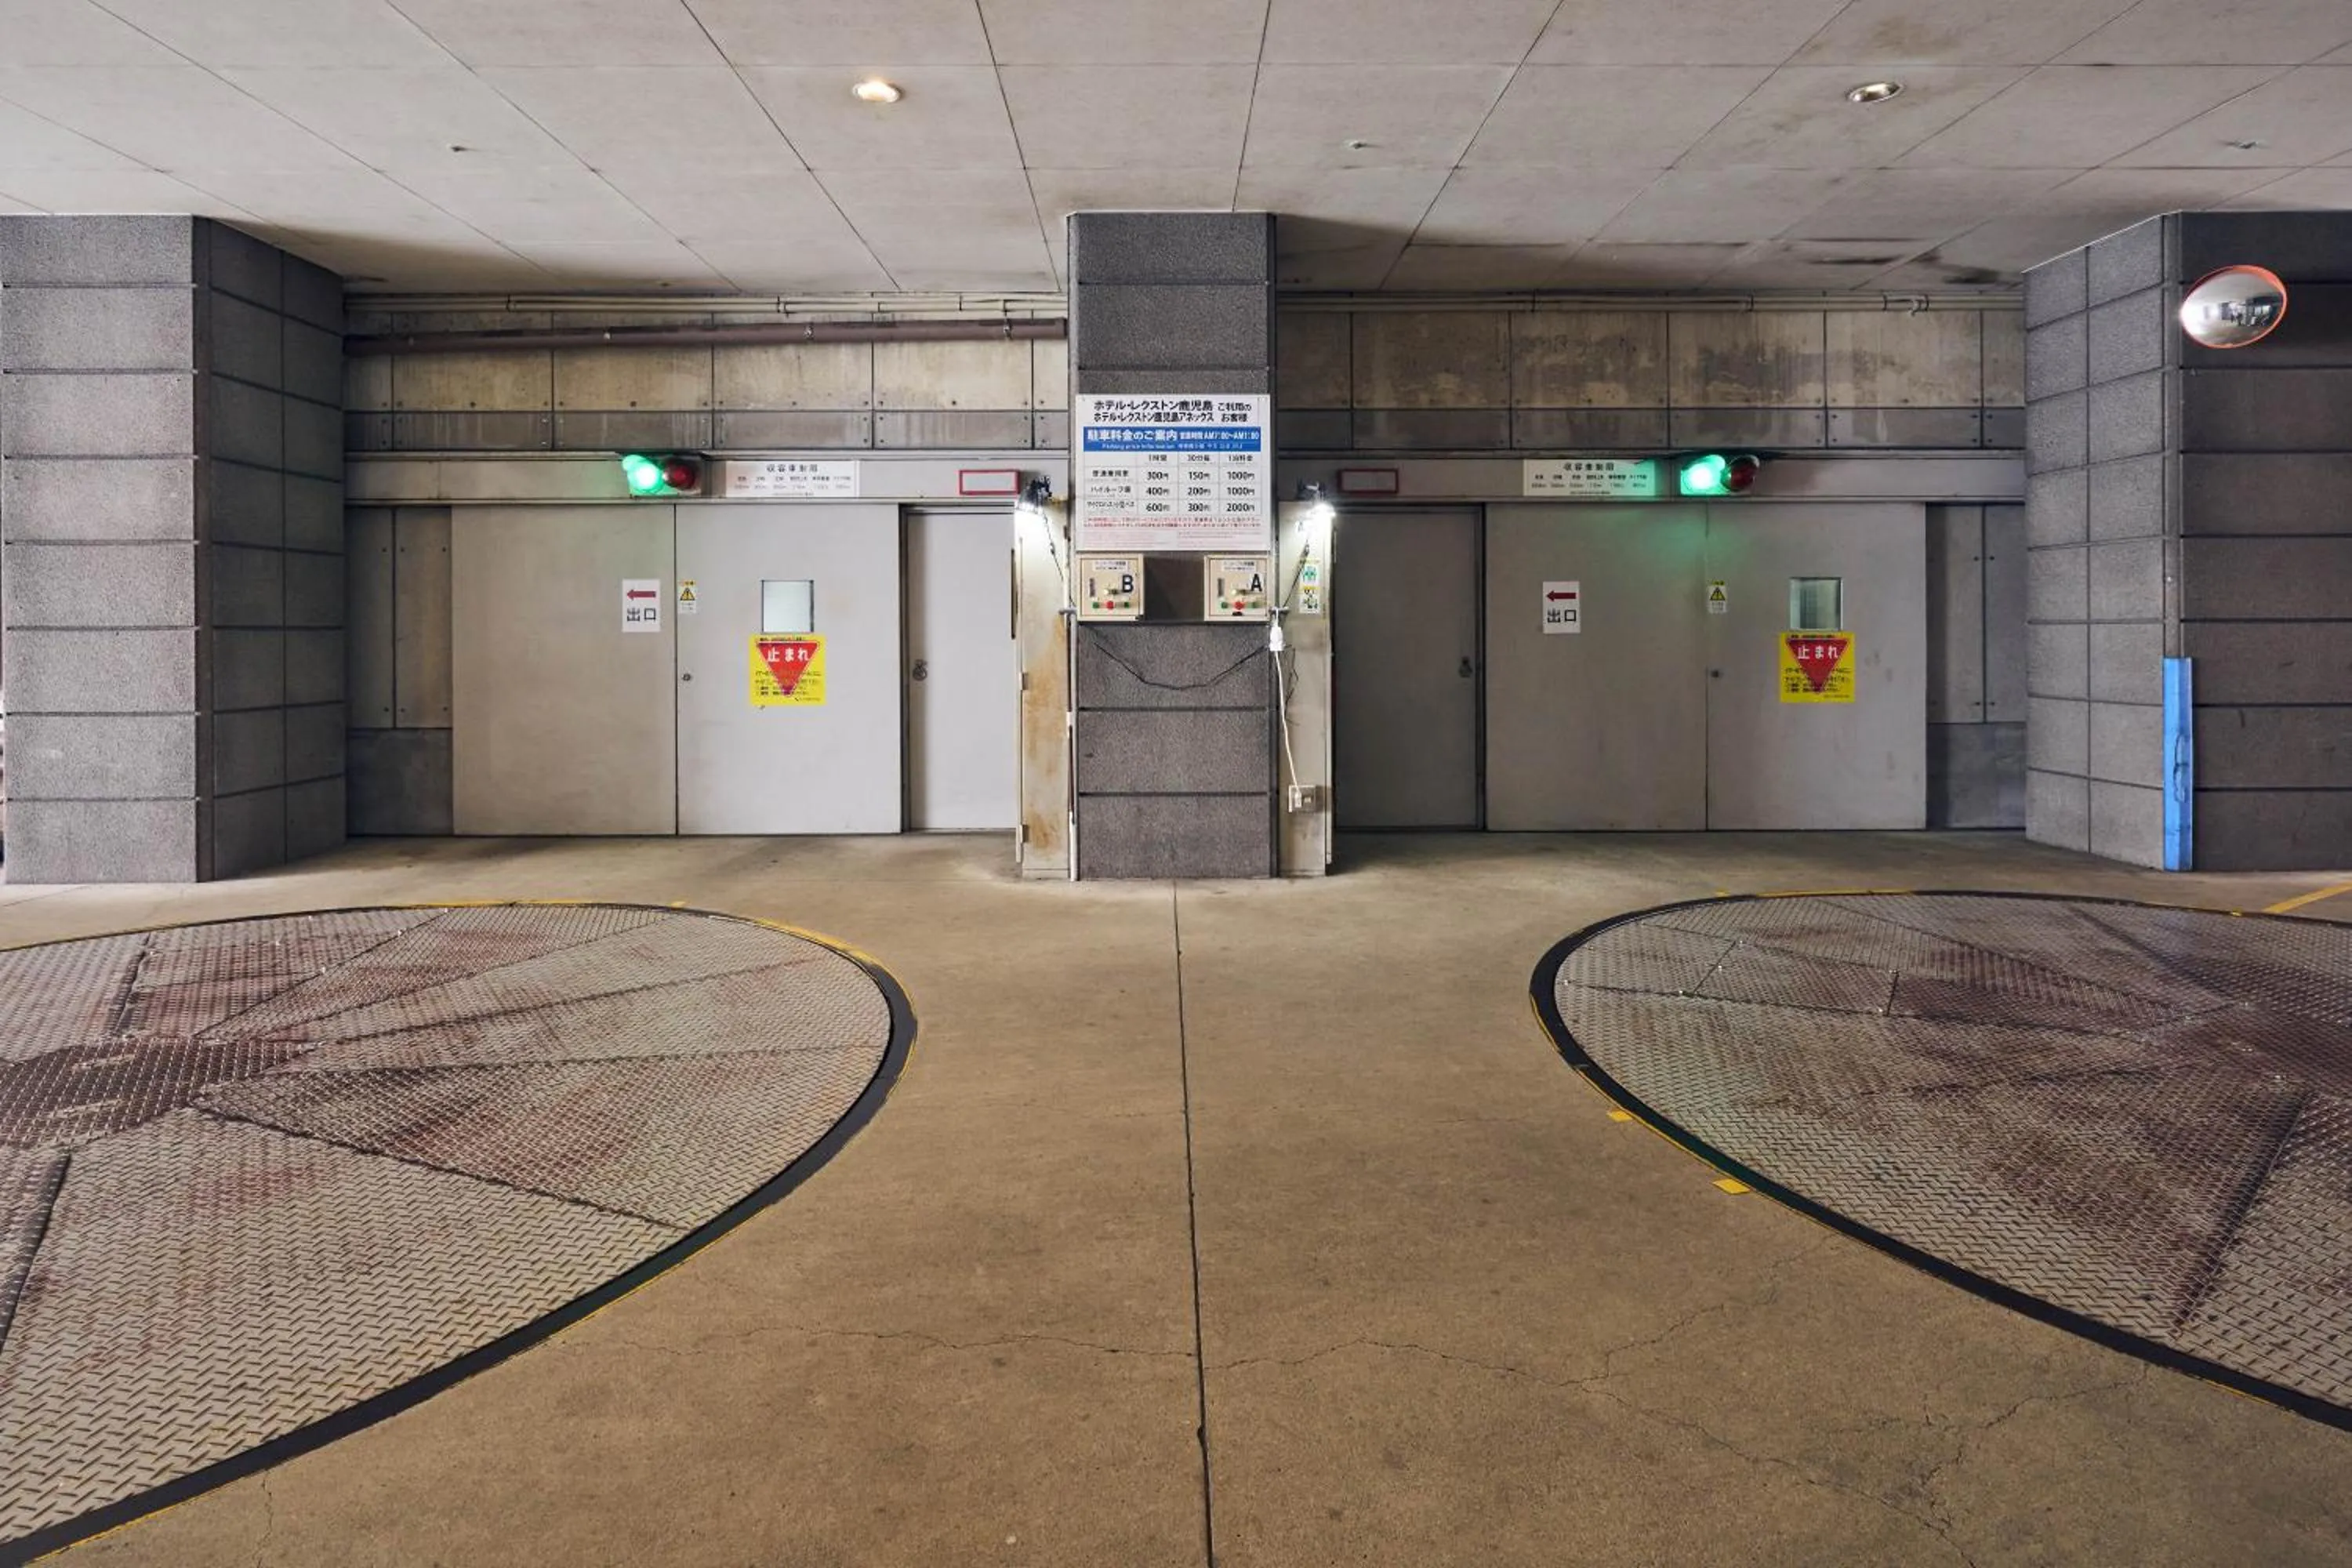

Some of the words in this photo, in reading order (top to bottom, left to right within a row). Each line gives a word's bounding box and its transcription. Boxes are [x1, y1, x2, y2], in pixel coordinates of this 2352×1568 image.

[1221, 412, 1248, 423] お客様
[1087, 429, 1178, 442] 駐車料金のご案内
[1145, 487, 1170, 495] 400円
[1188, 487, 1211, 495] 200円
[1145, 503, 1171, 512] 600円
[1188, 503, 1211, 512] 300円
[1122, 575, 1134, 593] B
[1250, 573, 1263, 592] A
[626, 607, 656, 622] 出口
[1548, 608, 1577, 623] 出口
[767, 647, 809, 662] 止まれ
[1798, 644, 1838, 659] 止まれ
